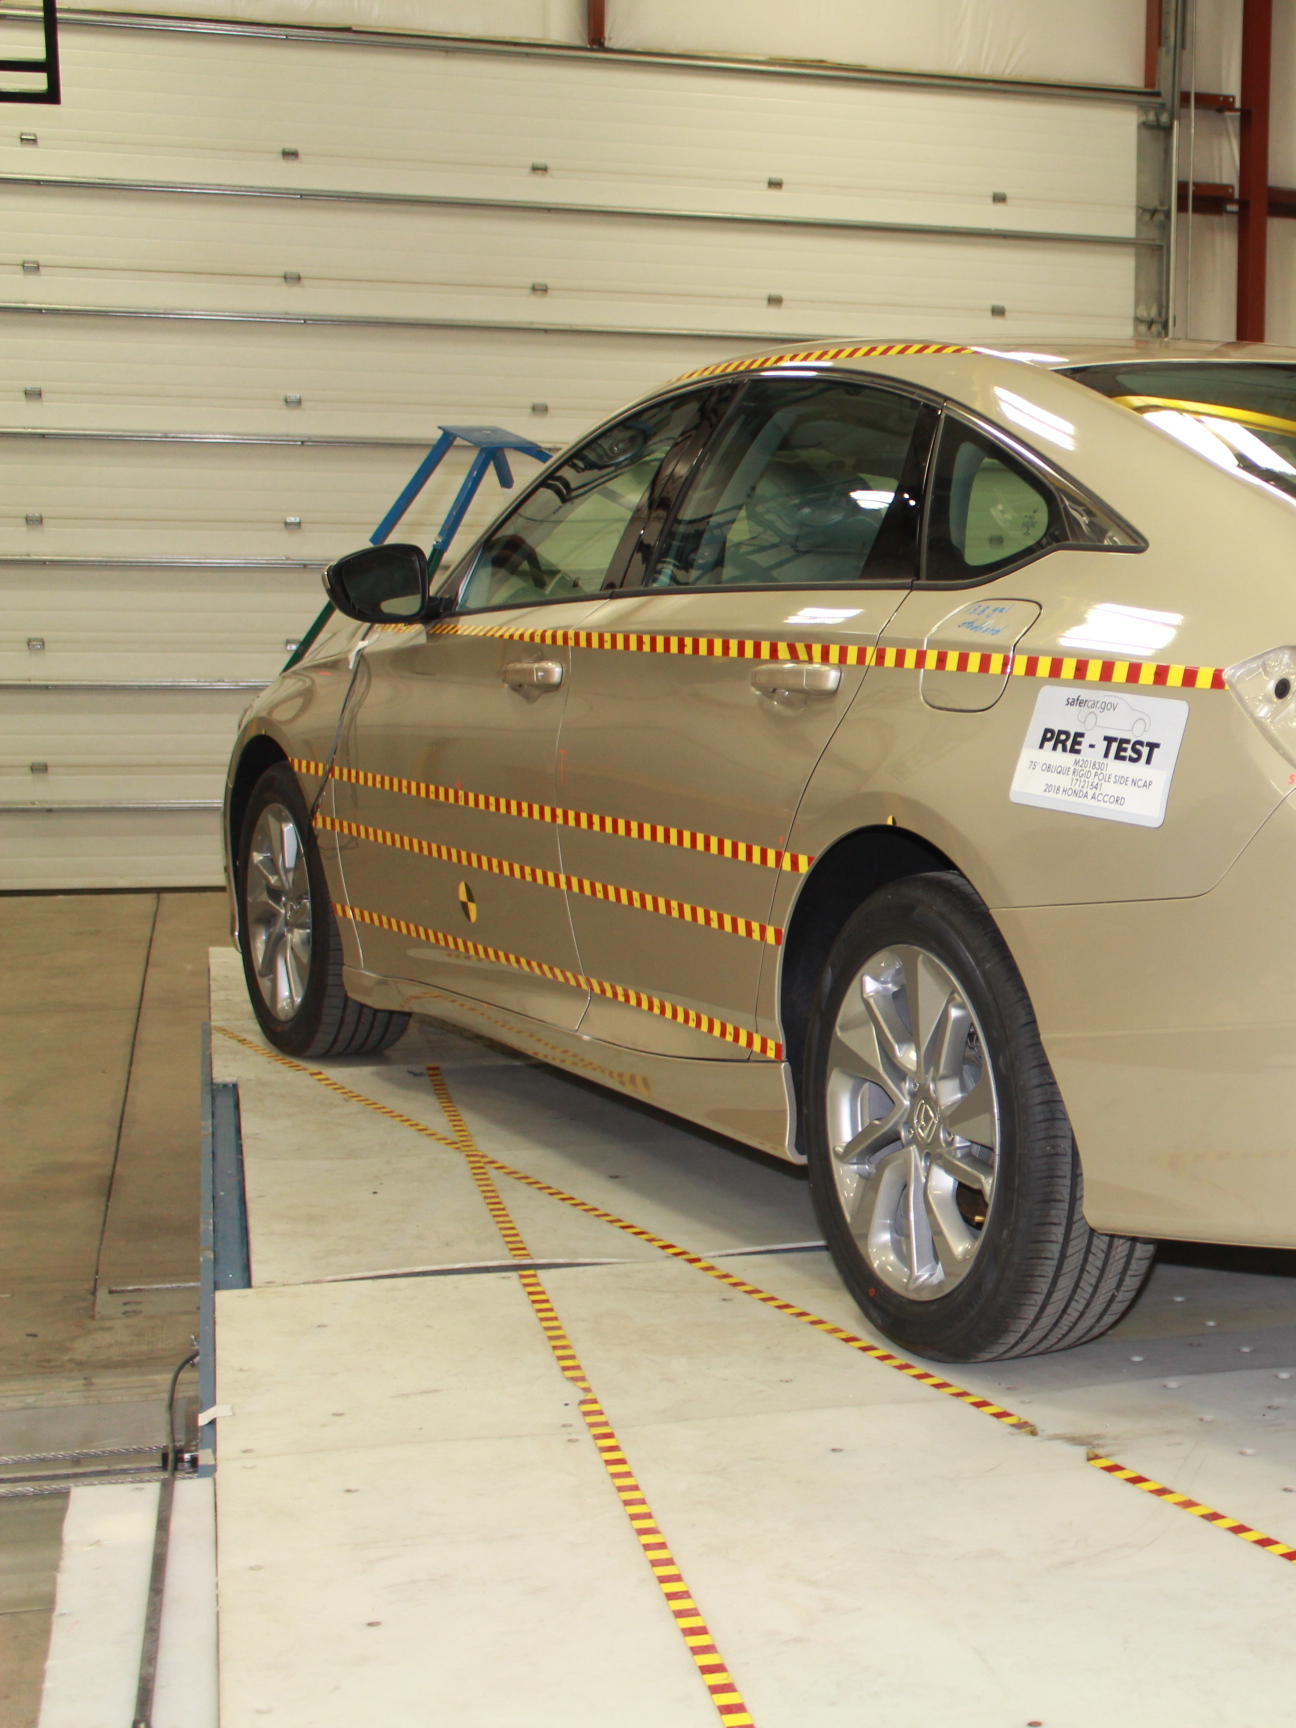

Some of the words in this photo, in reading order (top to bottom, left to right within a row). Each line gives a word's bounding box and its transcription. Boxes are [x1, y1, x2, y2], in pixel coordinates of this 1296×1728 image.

[1065, 694, 1119, 713] safercar.gov
[1038, 727, 1086, 755] PRE
[1103, 735, 1161, 766] TEST
[1073, 758, 1109, 771] M2018301
[1028, 761, 1041, 771] 75°
[1041, 763, 1071, 777] OBLIQUE
[1071, 767, 1092, 780] RIGID
[1093, 771, 1112, 783] POLE
[1114, 774, 1130, 786] SIDE
[1130, 776, 1153, 790] NCAP
[1070, 778, 1103, 792] 17121541
[1043, 783, 1061, 796] 2018
[1061, 786, 1089, 801] HONDA
[1090, 790, 1126, 806] ACCORD
